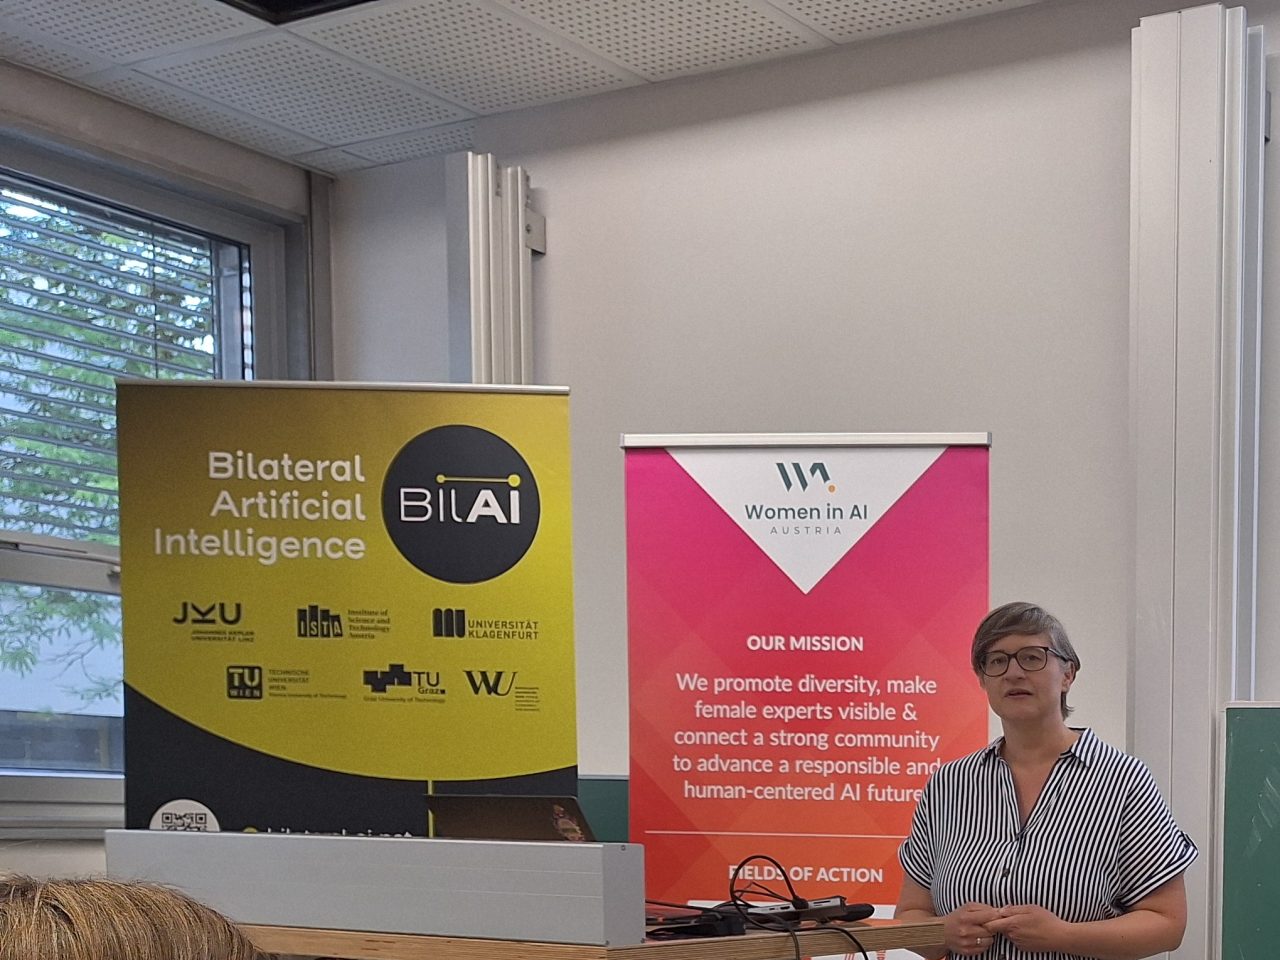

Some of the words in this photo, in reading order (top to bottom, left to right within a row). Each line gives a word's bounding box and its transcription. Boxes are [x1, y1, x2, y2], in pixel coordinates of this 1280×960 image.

[208, 451, 366, 483] Bilateral
[210, 490, 366, 522] Artificial
[745, 504, 821, 521] Women
[826, 503, 844, 520] in
[849, 504, 868, 521] AI
[770, 525, 842, 536] AUSTRIA
[154, 528, 366, 566] Intelligence
[300, 619, 342, 637] ISTA
[468, 619, 538, 630] UNIVERSITÄT
[468, 630, 538, 640] KLAGENFURT
[747, 635, 786, 652] OUR
[790, 635, 864, 652] MISSION
[228, 667, 260, 687] TU
[413, 671, 440, 687] TU
[463, 670, 518, 696] WU
[676, 673, 708, 691] We
[714, 676, 792, 694] promote
[798, 674, 881, 696] diversity,
[887, 675, 937, 694] make
[229, 688, 261, 698] WIEN
[418, 687, 441, 695] Graz
[694, 700, 757, 718] female
[762, 703, 833, 722] experts
[838, 702, 896, 720] visible
[902, 703, 918, 721] &
[674, 729, 748, 745] connect
[753, 732, 764, 745] a
[769, 731, 829, 750] strong
[834, 730, 940, 752] community
[672, 755, 691, 771] to
[697, 754, 773, 772] advance
[779, 760, 790, 773] a
[795, 756, 900, 776] responsible
[906, 758, 941, 775] and
[684, 781, 834, 801] human-centered
[840, 784, 860, 801] AI
[789, 866, 813, 881] OF
[816, 867, 883, 883] ACTION
